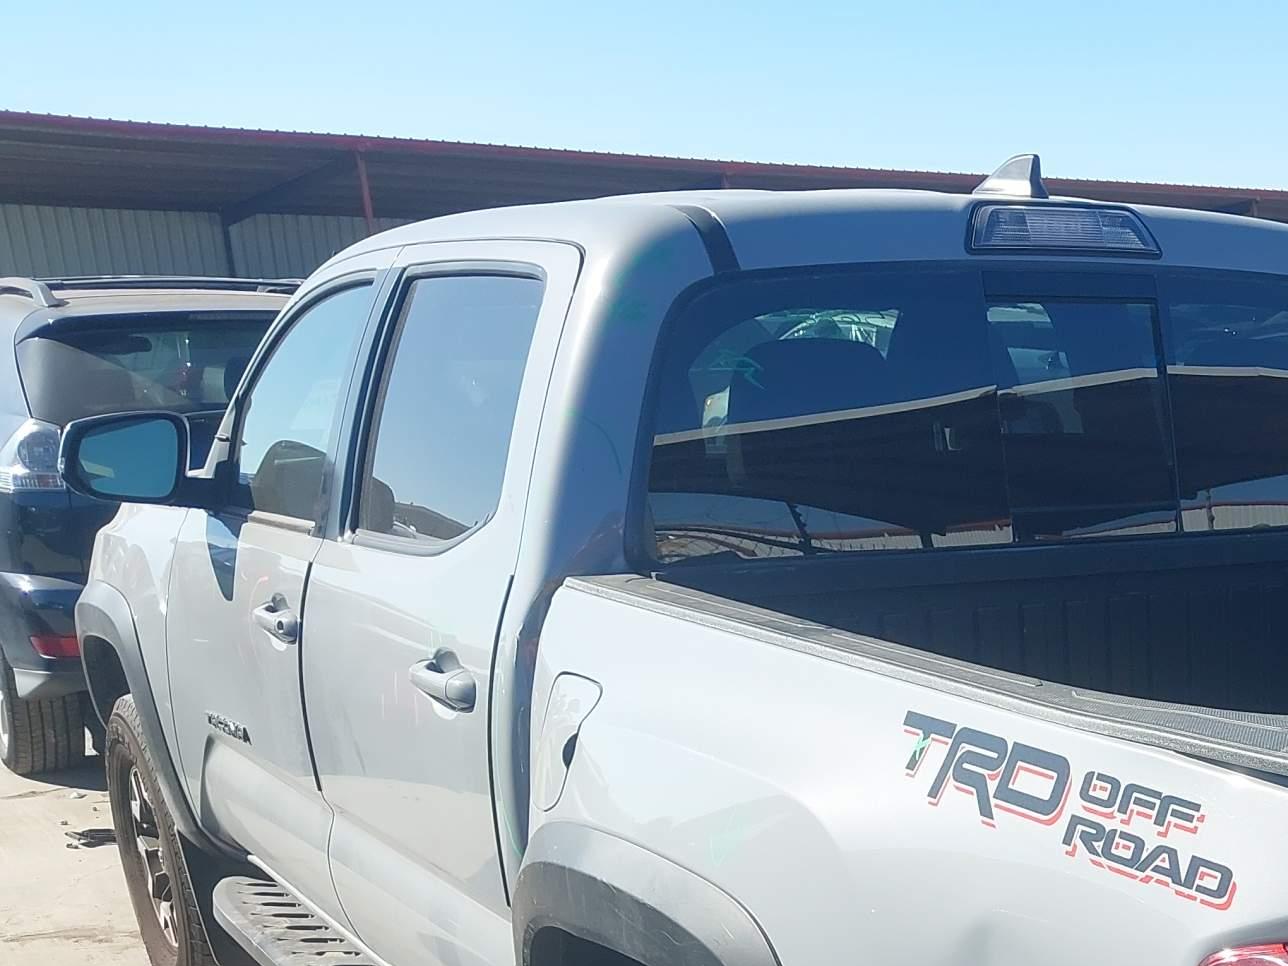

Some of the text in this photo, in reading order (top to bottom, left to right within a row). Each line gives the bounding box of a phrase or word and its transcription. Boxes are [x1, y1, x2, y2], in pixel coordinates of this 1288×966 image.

[903, 709, 1073, 828] TRD
[1078, 770, 1207, 838] OFF
[1061, 814, 1238, 912] ROAD
